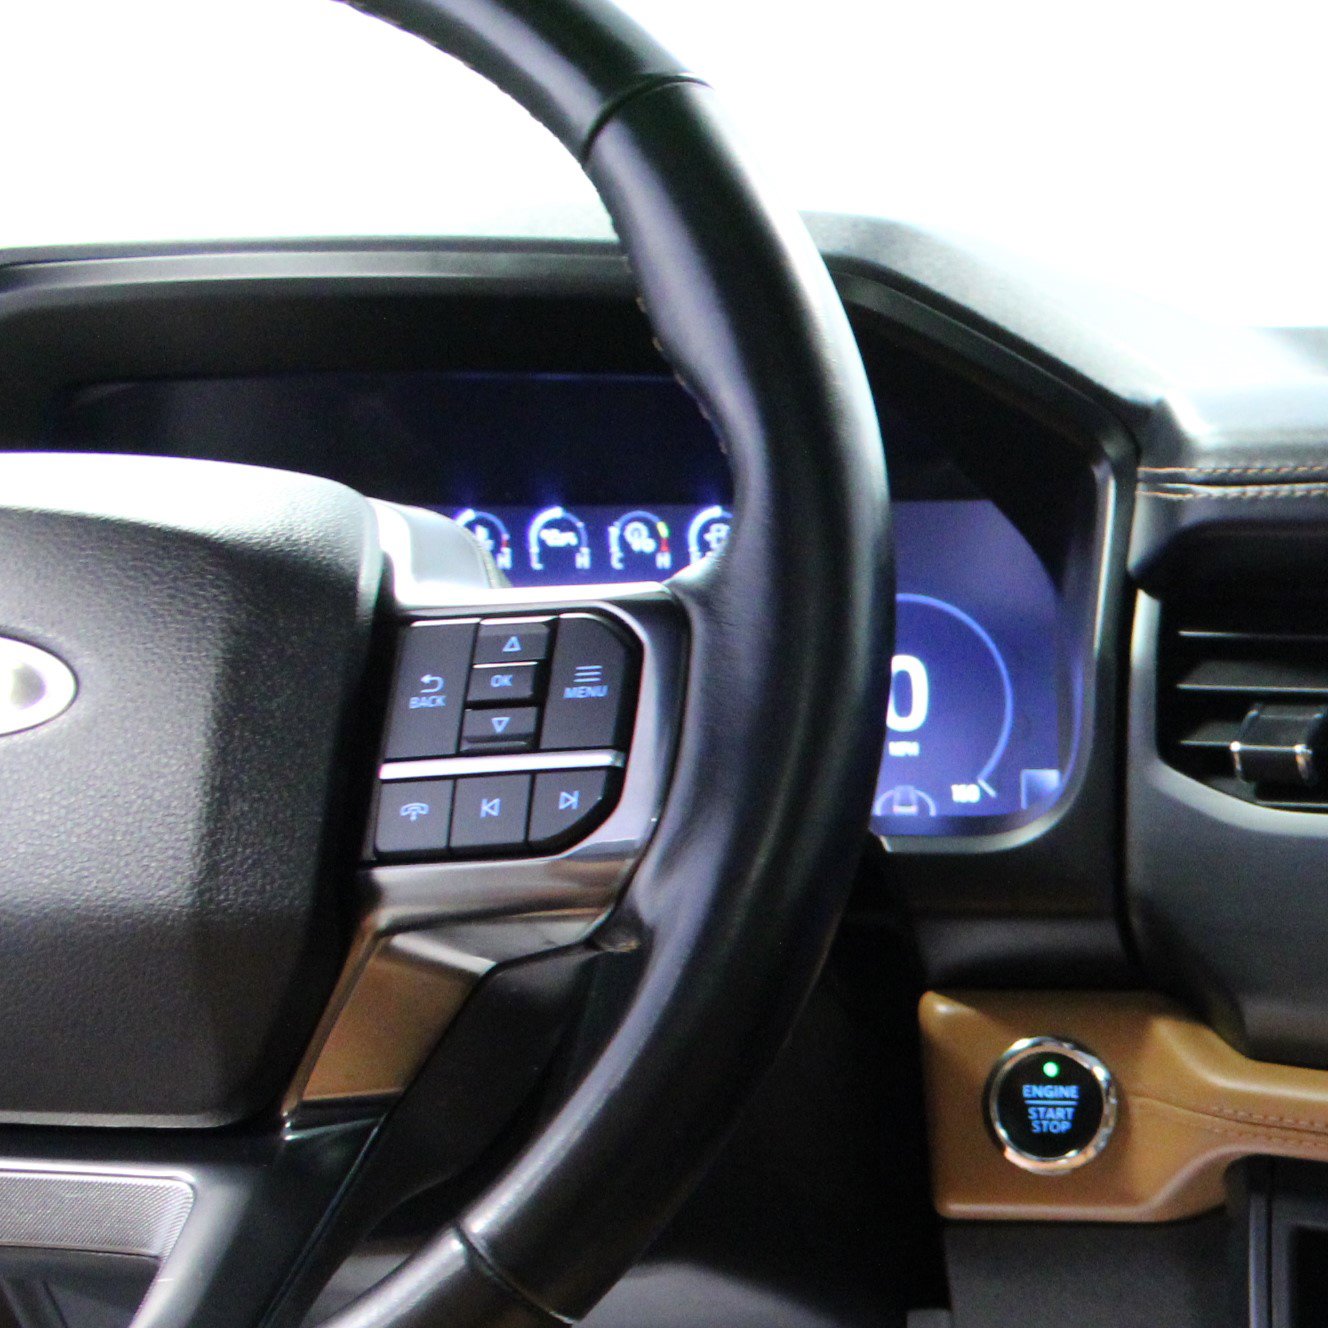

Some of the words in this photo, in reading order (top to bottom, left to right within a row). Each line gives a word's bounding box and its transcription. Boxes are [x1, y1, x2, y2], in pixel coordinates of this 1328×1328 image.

[490, 674, 513, 688] OK
[563, 685, 608, 700] MENU
[409, 695, 446, 710] BACK
[1022, 1084, 1080, 1099] ENGINE
[1028, 1107, 1075, 1121] START
[1031, 1120, 1072, 1134] STOP
